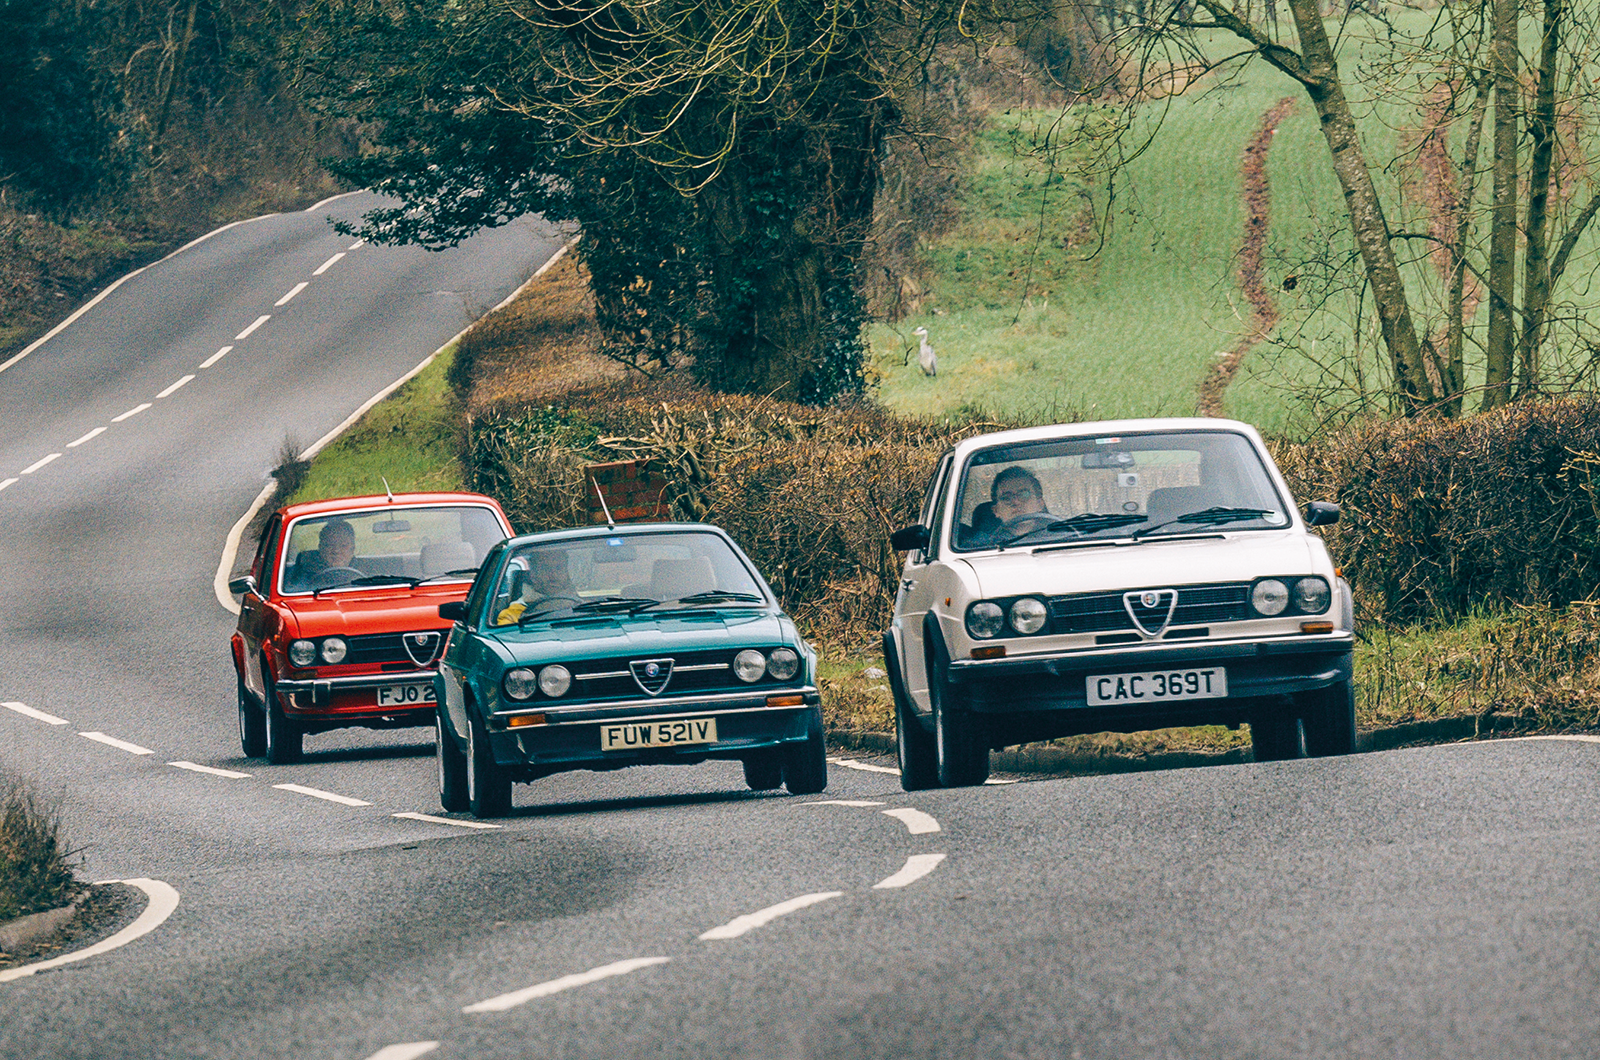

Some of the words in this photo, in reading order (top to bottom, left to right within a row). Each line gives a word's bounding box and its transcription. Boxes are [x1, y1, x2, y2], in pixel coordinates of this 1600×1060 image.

[1097, 676, 1145, 700] CAC
[1152, 670, 1215, 697] 369T
[608, 725, 652, 746] FUW
[658, 721, 709, 743] 521V
